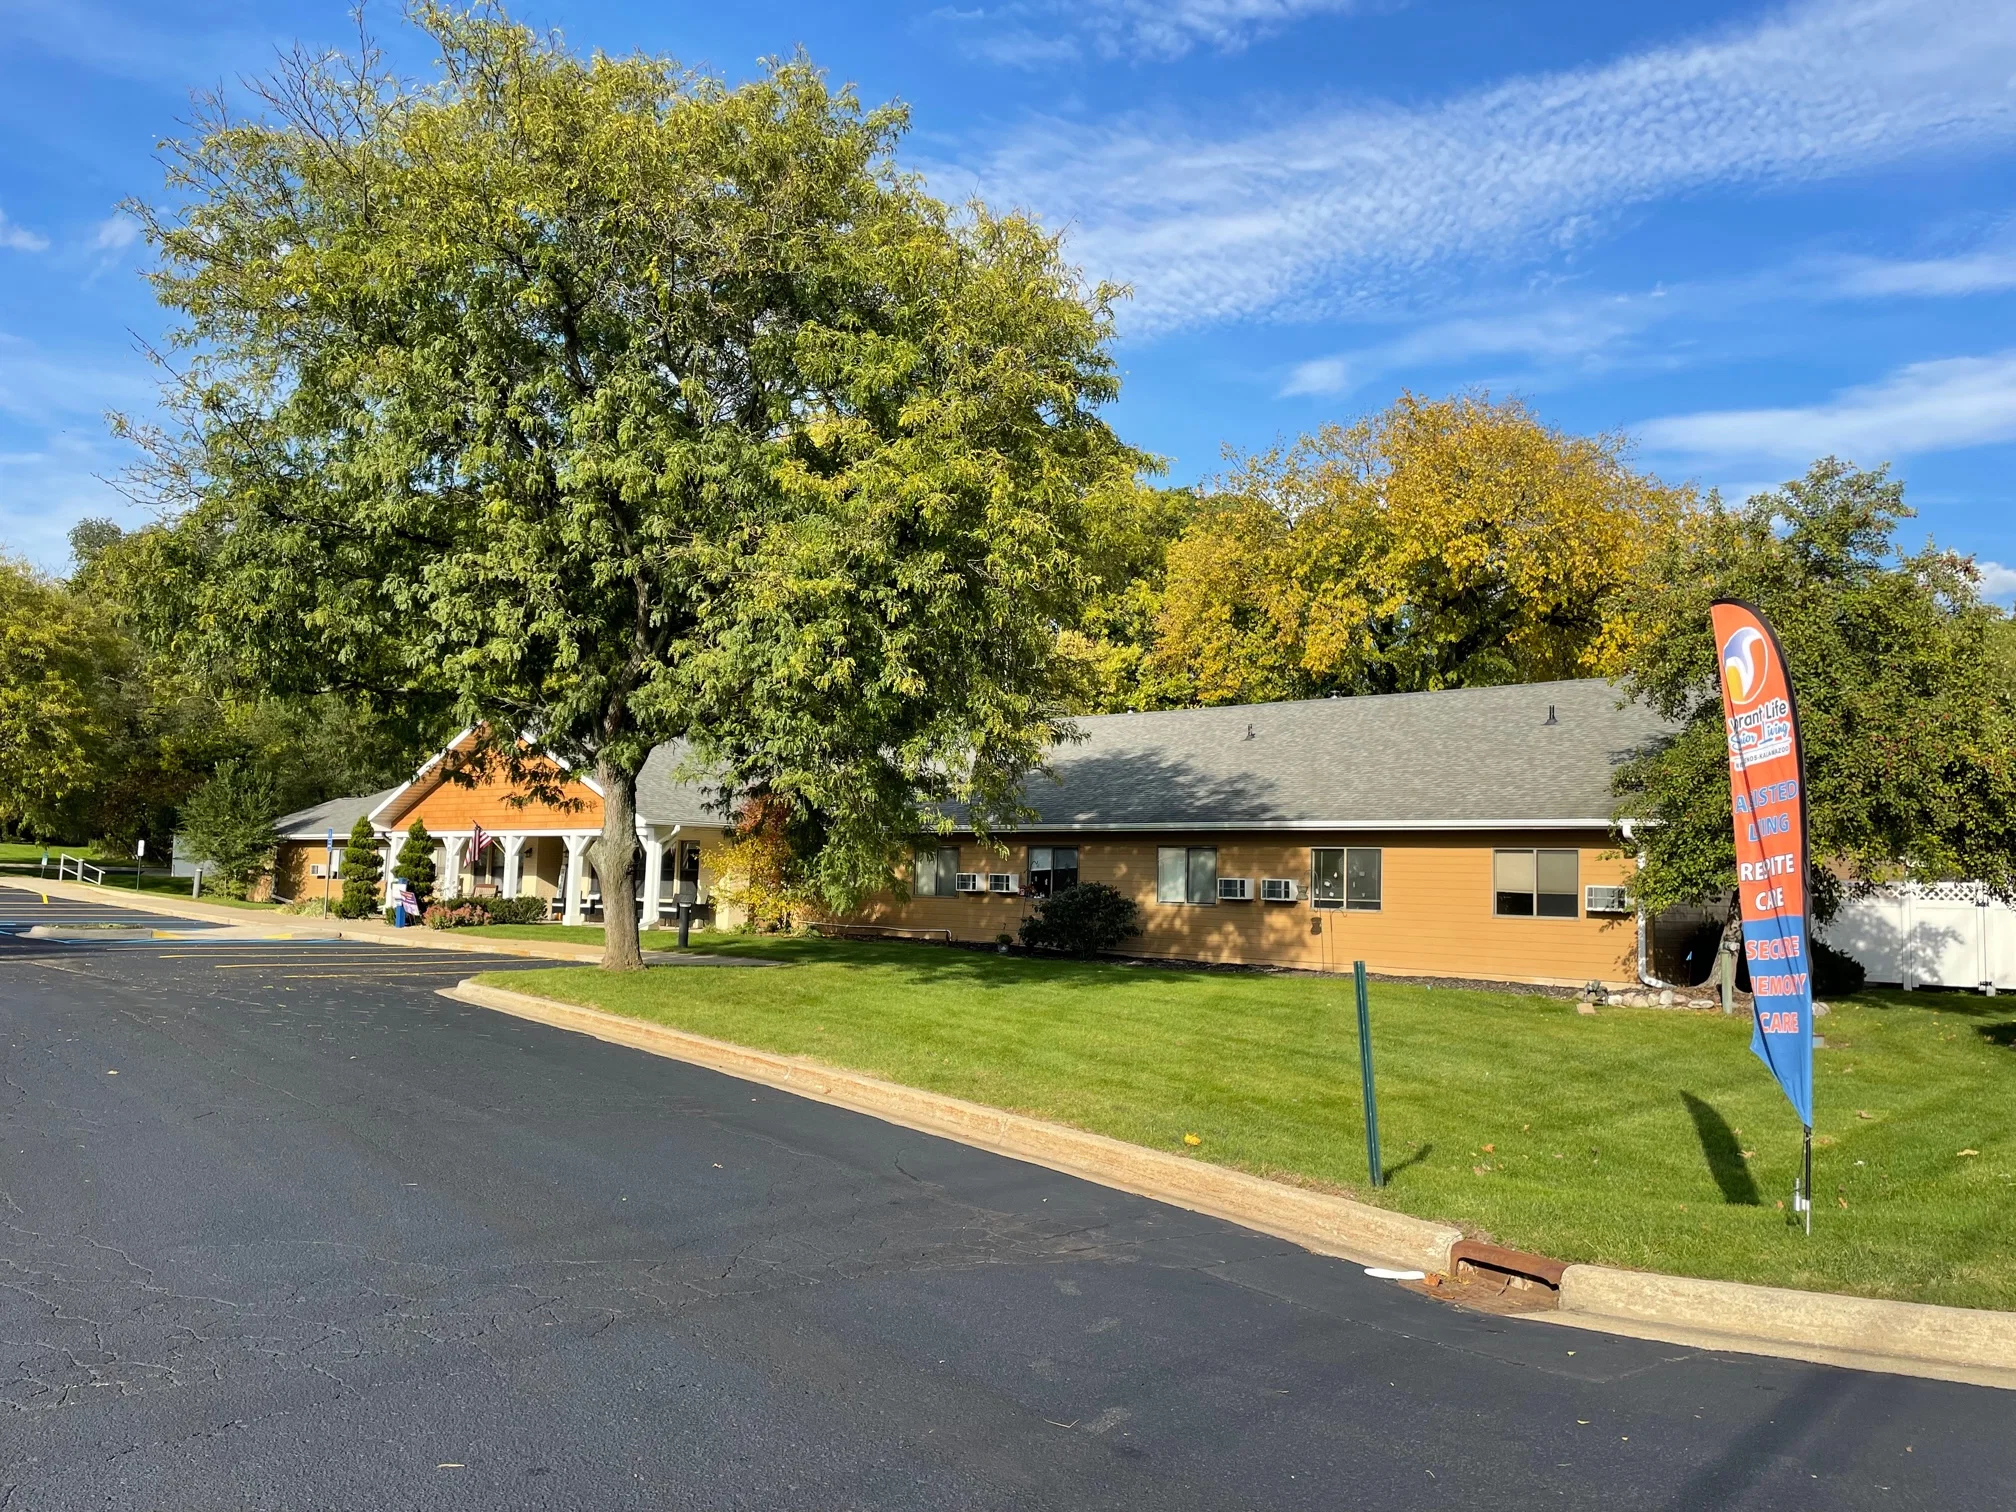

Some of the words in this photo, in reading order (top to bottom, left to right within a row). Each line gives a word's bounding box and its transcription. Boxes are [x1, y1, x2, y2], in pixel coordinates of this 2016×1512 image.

[1765, 699, 1787, 719] Life
[1748, 813, 1790, 841] LING
[1760, 1011, 1799, 1034] CARE
